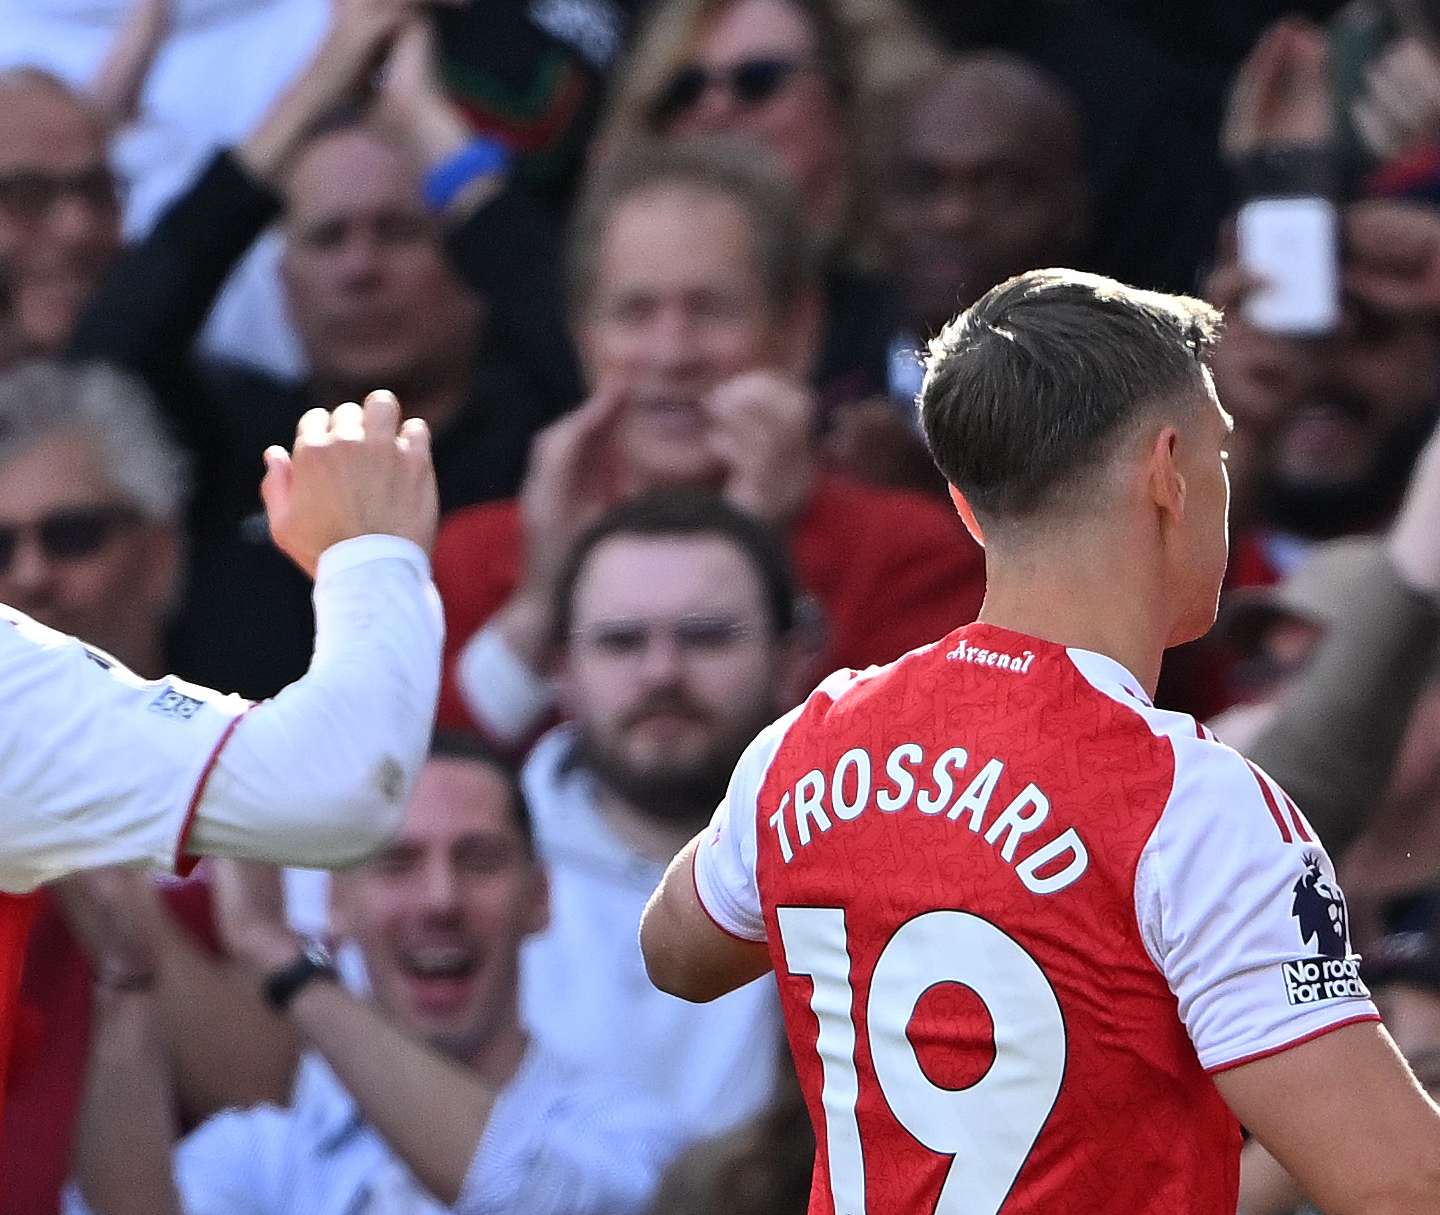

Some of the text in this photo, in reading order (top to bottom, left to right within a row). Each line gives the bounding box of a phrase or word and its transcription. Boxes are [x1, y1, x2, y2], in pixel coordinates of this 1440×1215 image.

[946, 640, 1035, 674] Arsenal
[769, 743, 1089, 895] TROSSARD
[1283, 961, 1319, 983] No
[1287, 981, 1320, 1003] for
